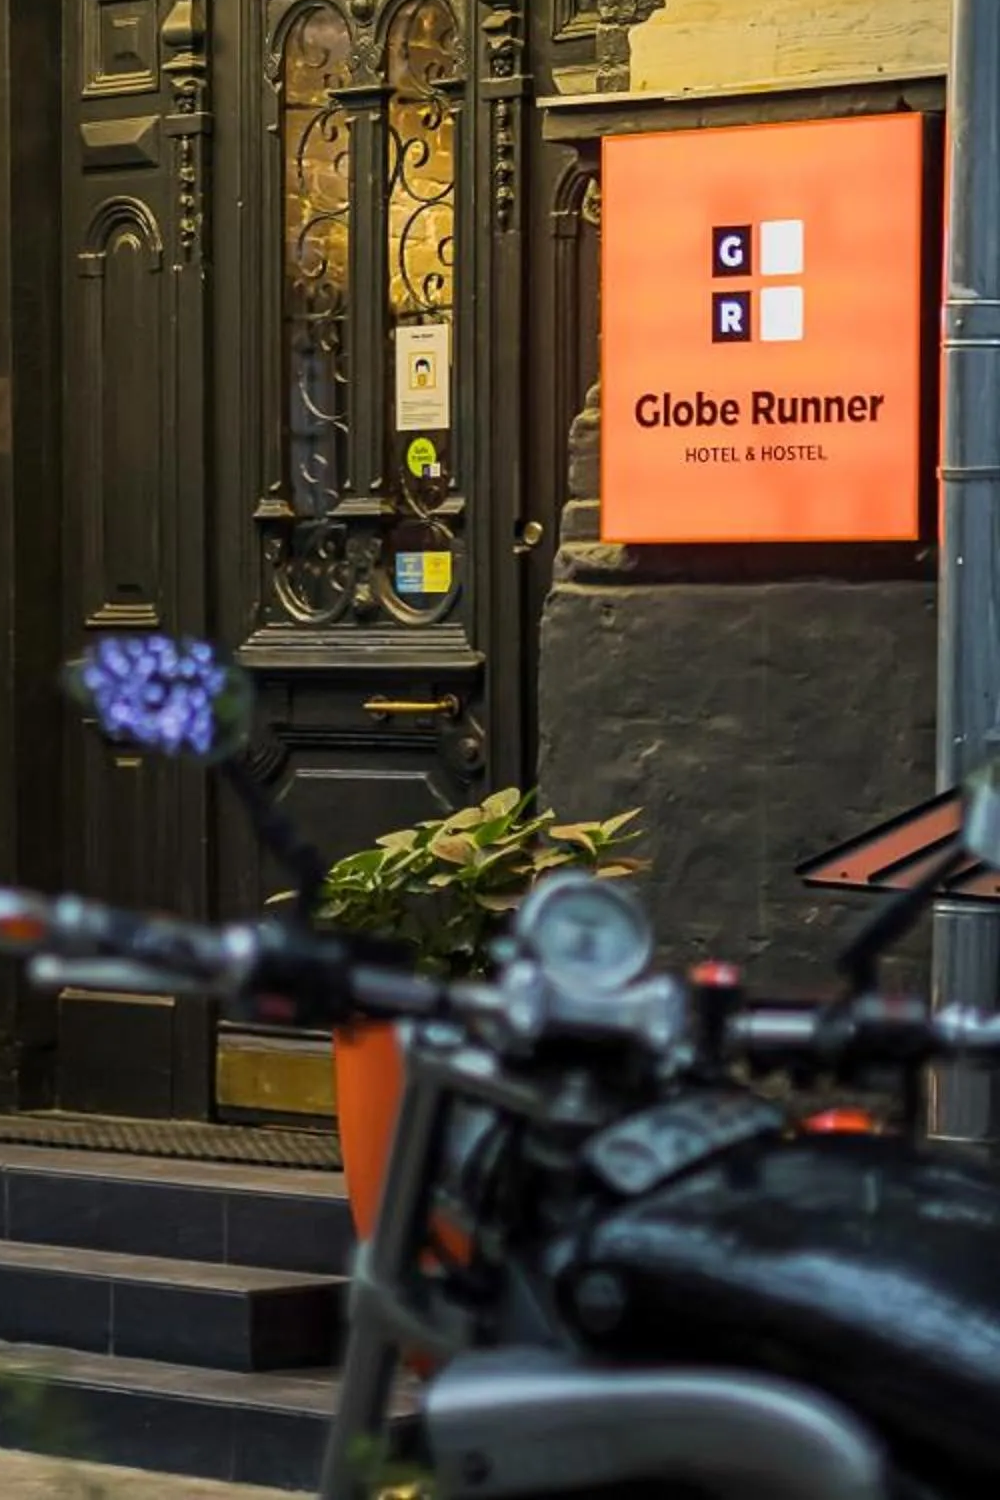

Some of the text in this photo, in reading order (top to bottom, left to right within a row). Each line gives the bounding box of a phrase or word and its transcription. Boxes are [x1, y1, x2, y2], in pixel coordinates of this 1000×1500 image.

[719, 235, 743, 267] G
[720, 301, 743, 333] R
[635, 390, 884, 428] Globe Runner
[685, 445, 827, 463] HOTEL & HOSTEL
